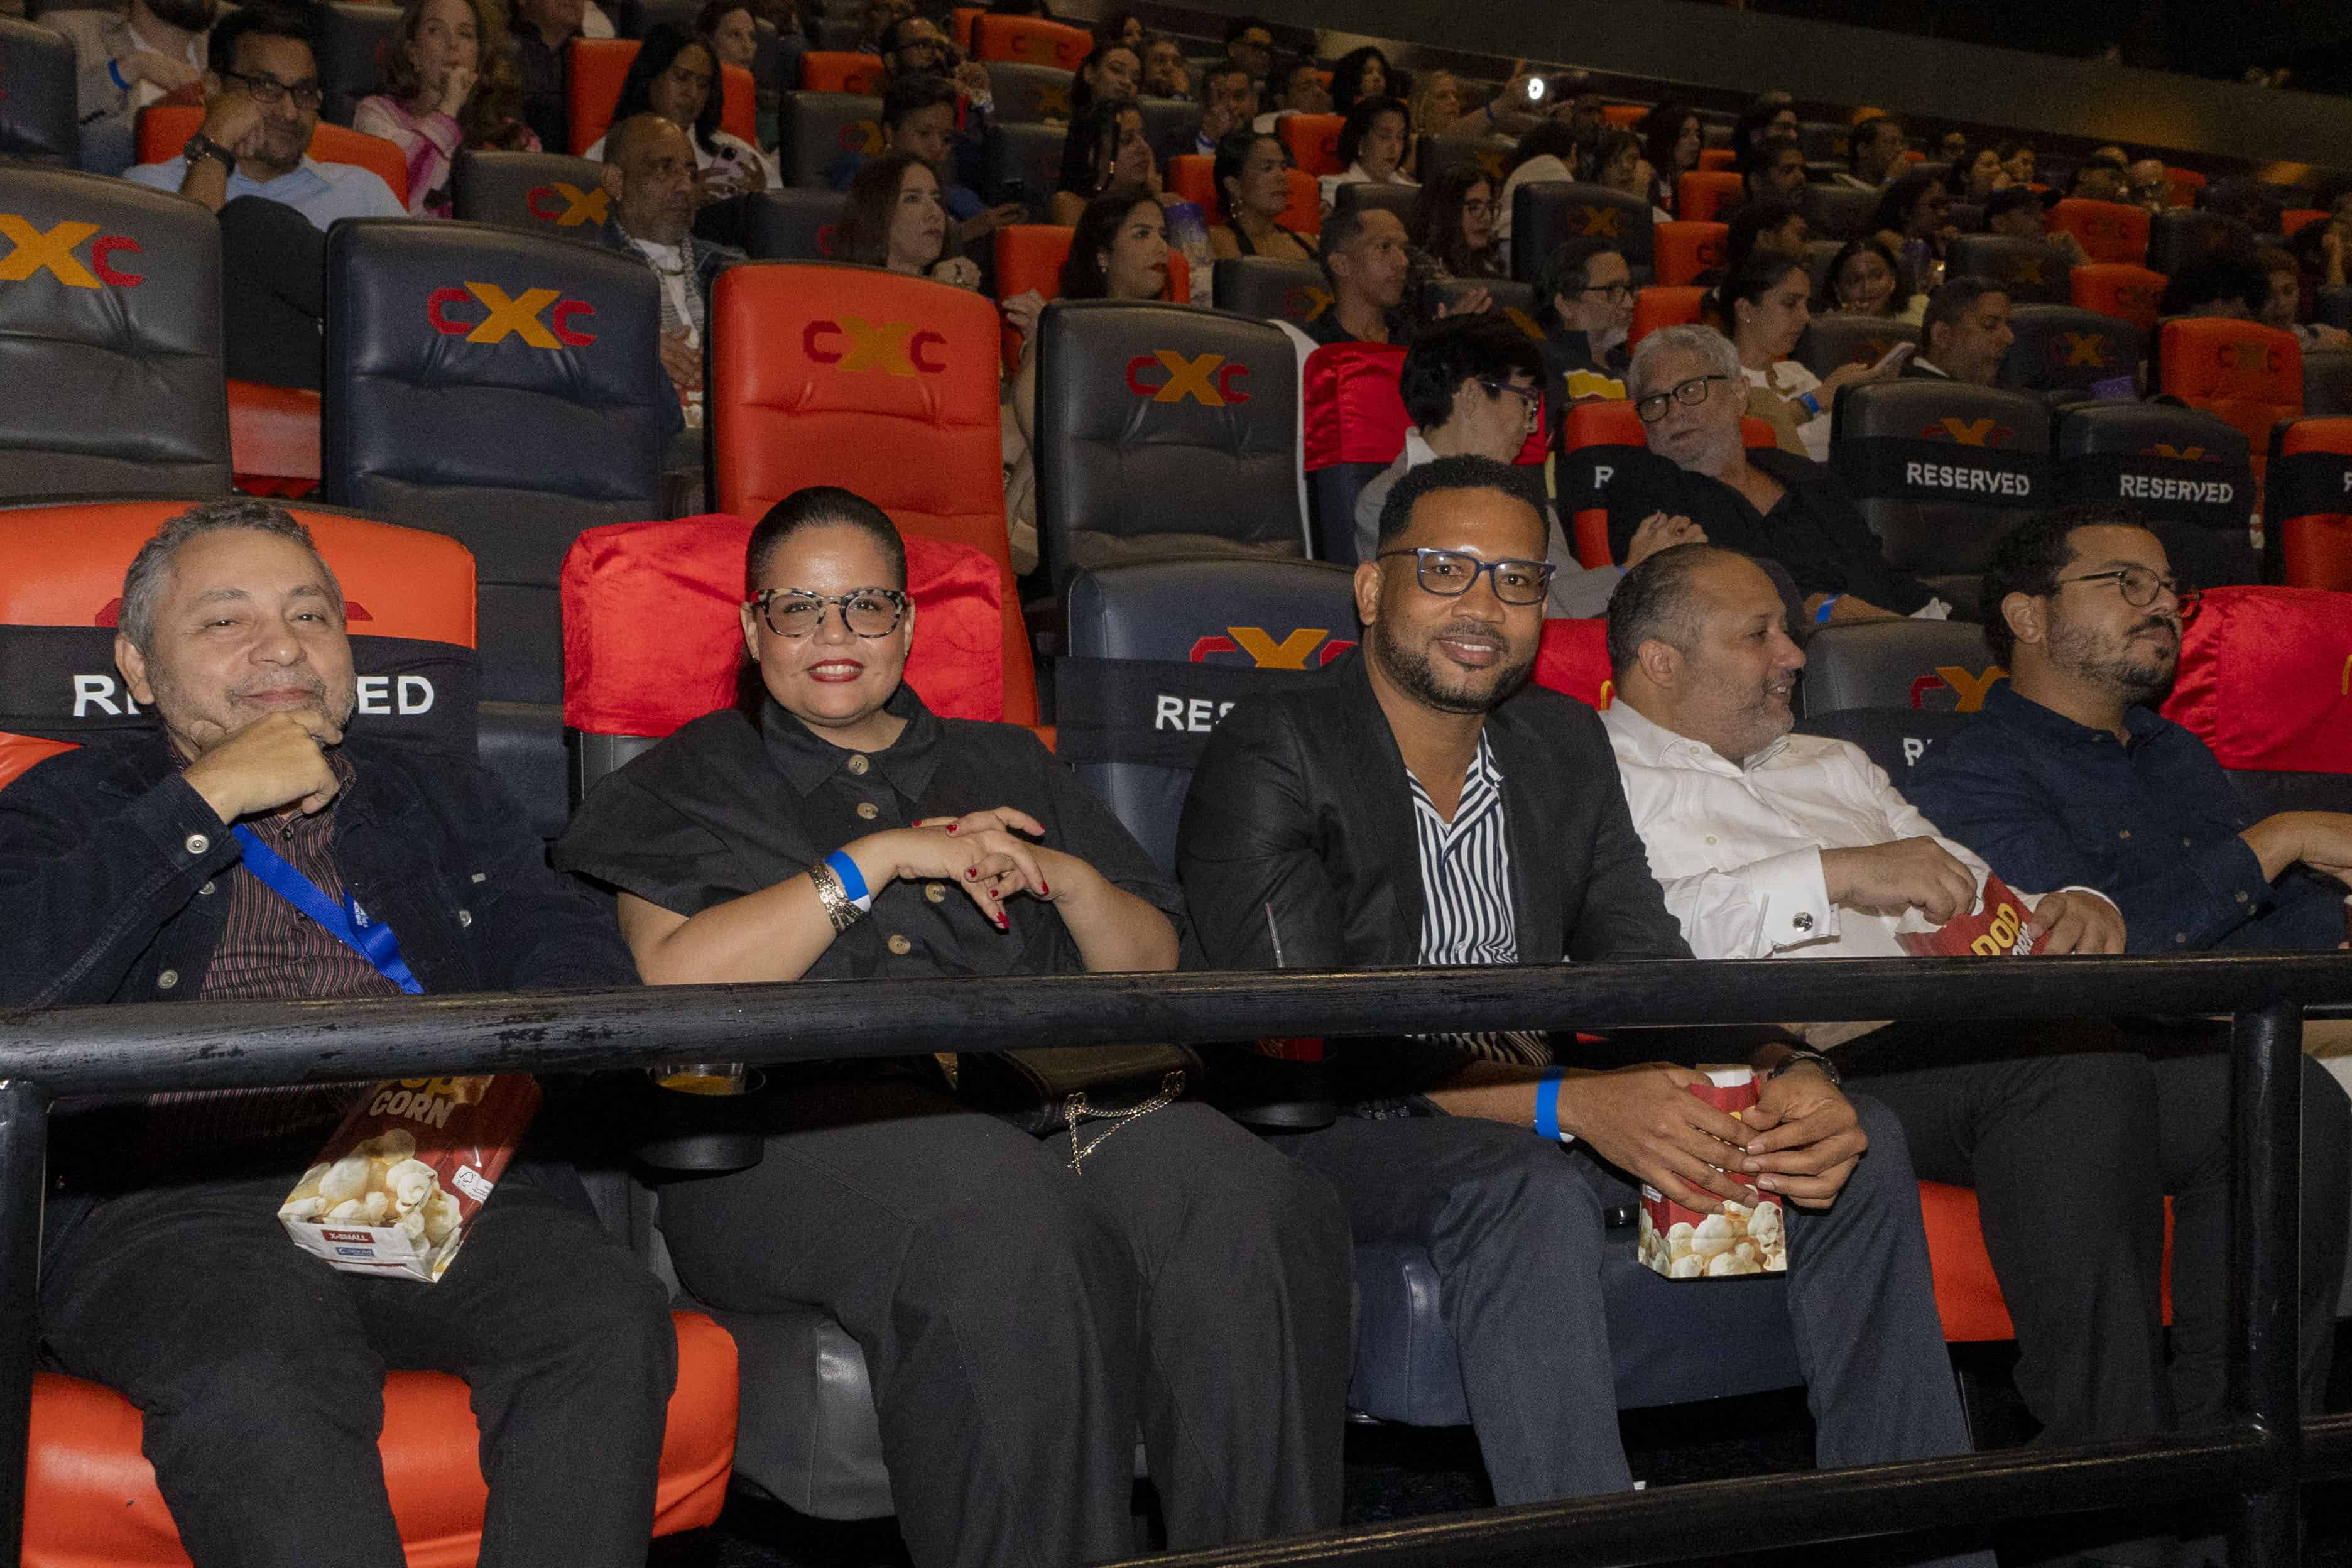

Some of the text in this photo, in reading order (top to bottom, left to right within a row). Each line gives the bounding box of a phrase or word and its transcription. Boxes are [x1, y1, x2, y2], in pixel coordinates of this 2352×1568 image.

[526, 182, 610, 227] CX
[0, 214, 144, 289] XC
[427, 281, 596, 349] CXC
[803, 315, 947, 377] CXC
[1126, 349, 1251, 407] CXC
[1906, 461, 2031, 498] RESERVED
[2119, 474, 2234, 503] RESERVED
[369, 1090, 455, 1129] CORN
